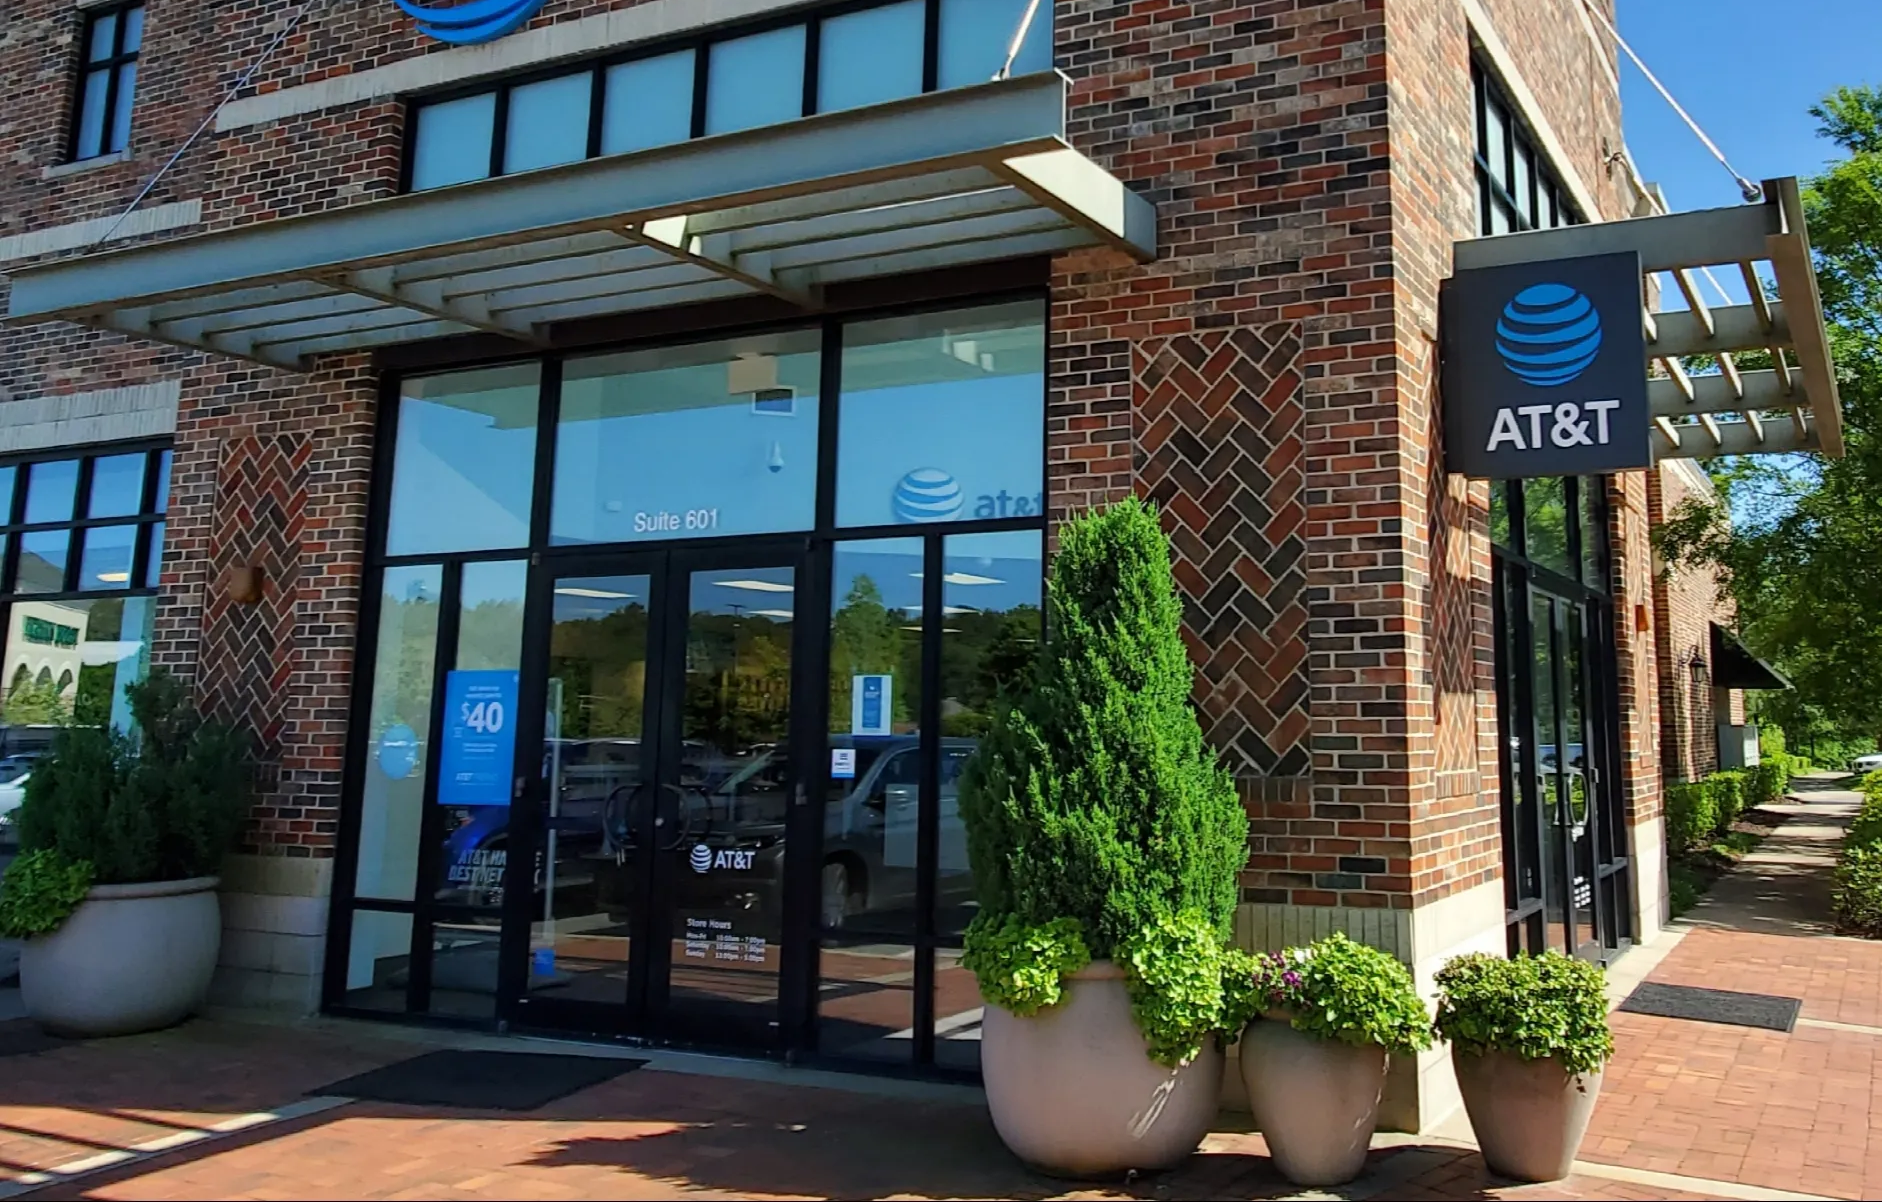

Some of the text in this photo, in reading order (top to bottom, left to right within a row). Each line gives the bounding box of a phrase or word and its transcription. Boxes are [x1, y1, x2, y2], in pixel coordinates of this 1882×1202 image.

[1486, 399, 1620, 451] AT&T
[634, 508, 717, 532] Suite 601
[461, 701, 504, 733] $40
[713, 850, 756, 870] AT&T
[686, 918, 732, 930] Store Hours
